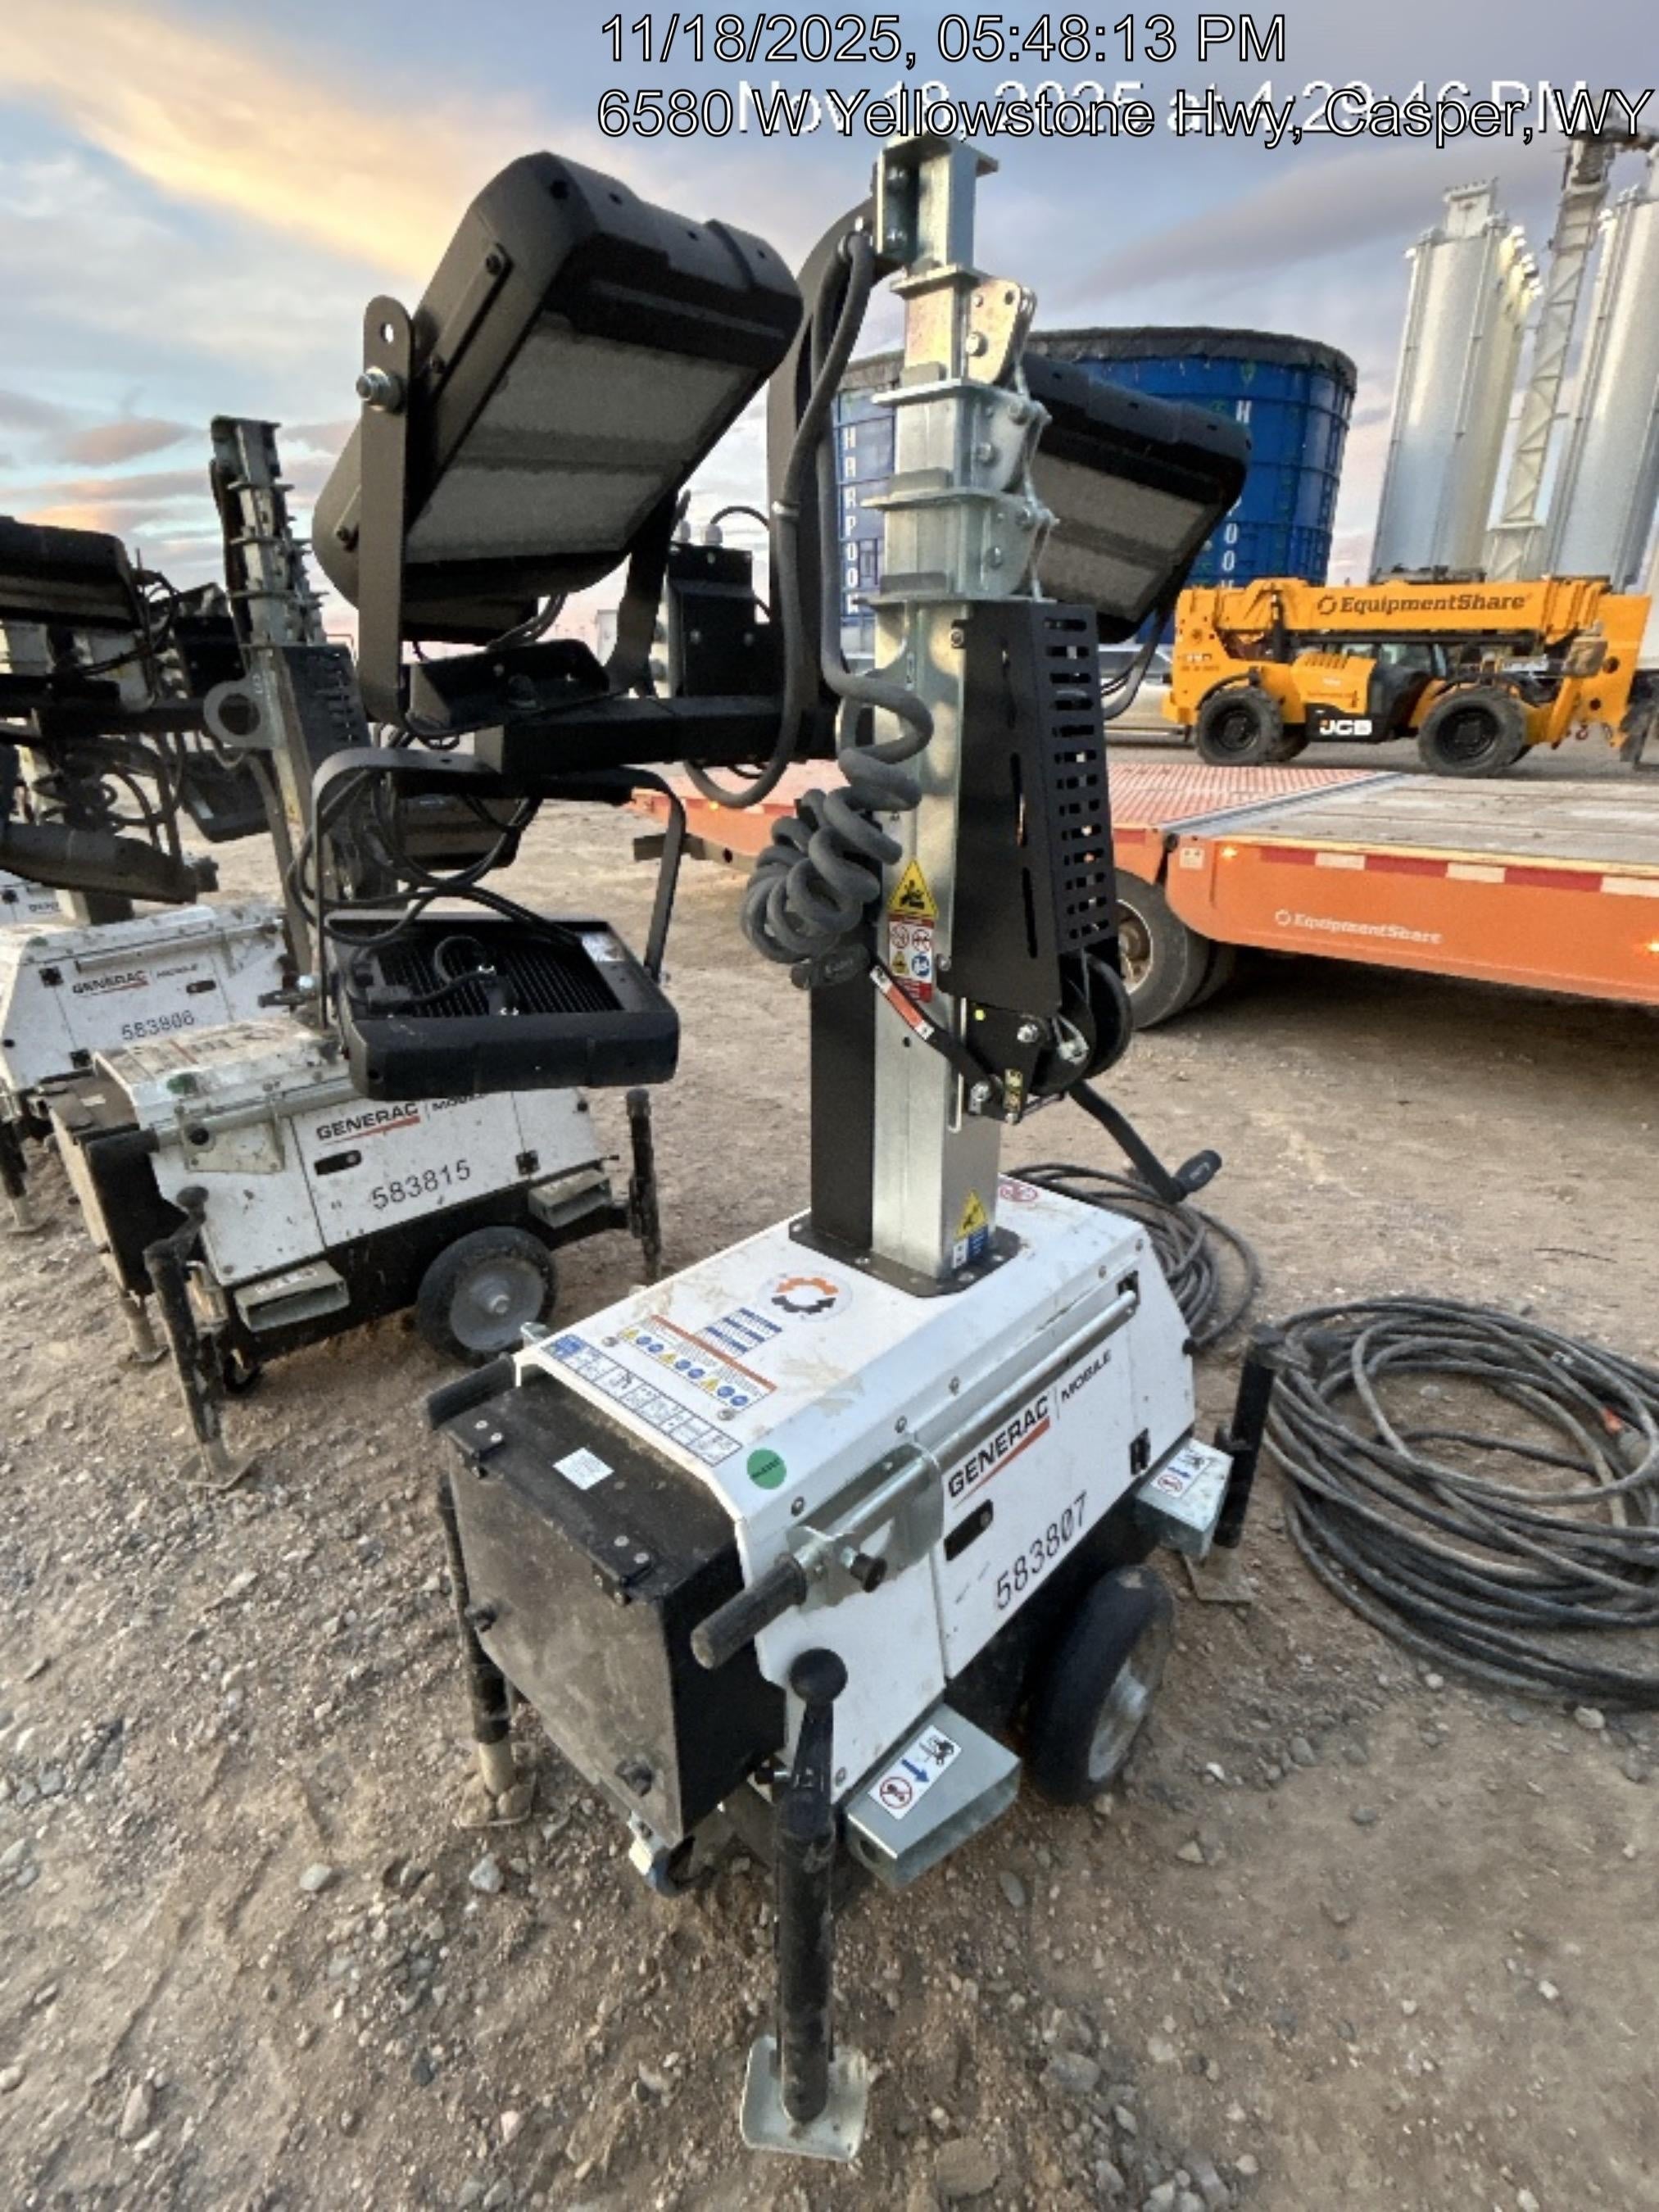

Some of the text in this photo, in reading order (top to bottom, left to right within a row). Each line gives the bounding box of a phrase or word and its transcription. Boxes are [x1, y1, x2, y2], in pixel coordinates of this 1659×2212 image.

[1340, 593, 1525, 615] EquipmentShare
[1319, 718, 1372, 736] JCB
[1294, 913, 1442, 944] EquipmentShare
[316, 1102, 419, 1141] GENERAC
[372, 1158, 470, 1210] 583815
[948, 1349, 1113, 1498] GENERAC MOBILE
[996, 1489, 1087, 1611] 583807
